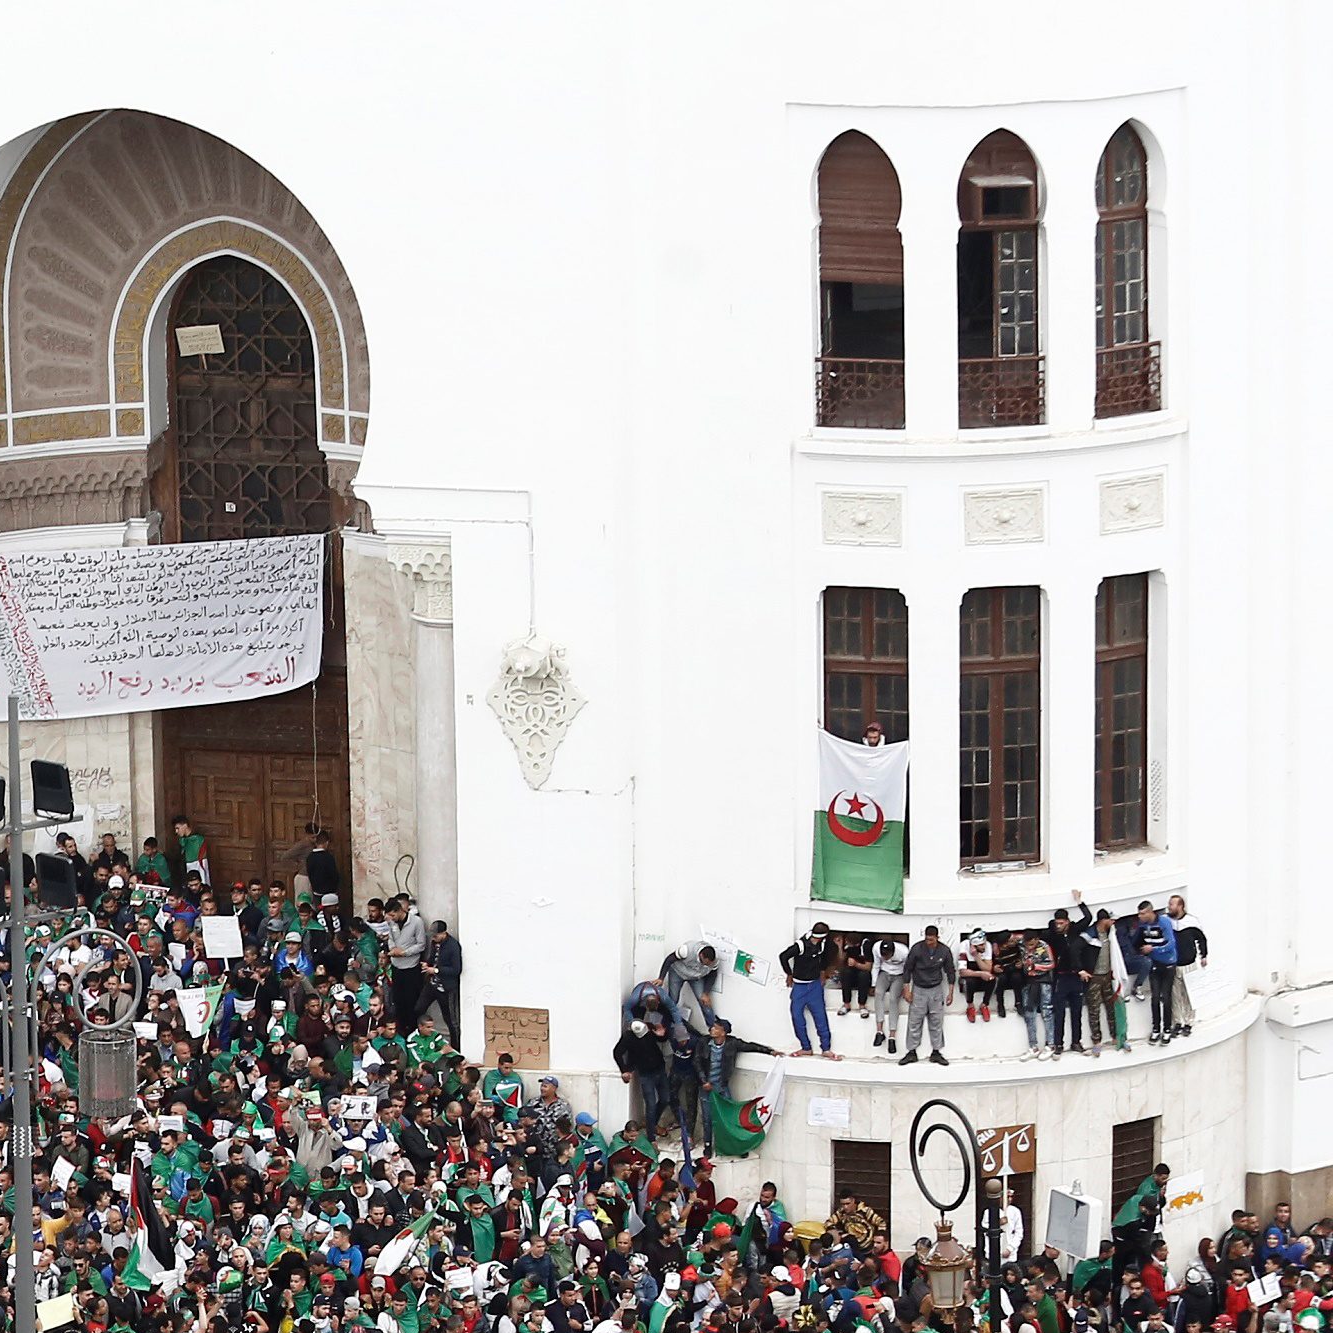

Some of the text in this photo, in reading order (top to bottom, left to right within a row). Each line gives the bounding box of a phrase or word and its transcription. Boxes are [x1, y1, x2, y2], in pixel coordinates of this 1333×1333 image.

[119, 670, 153, 700] رفع
[162, 676, 205, 695] يريد
[211, 656, 295, 694] الشعب
